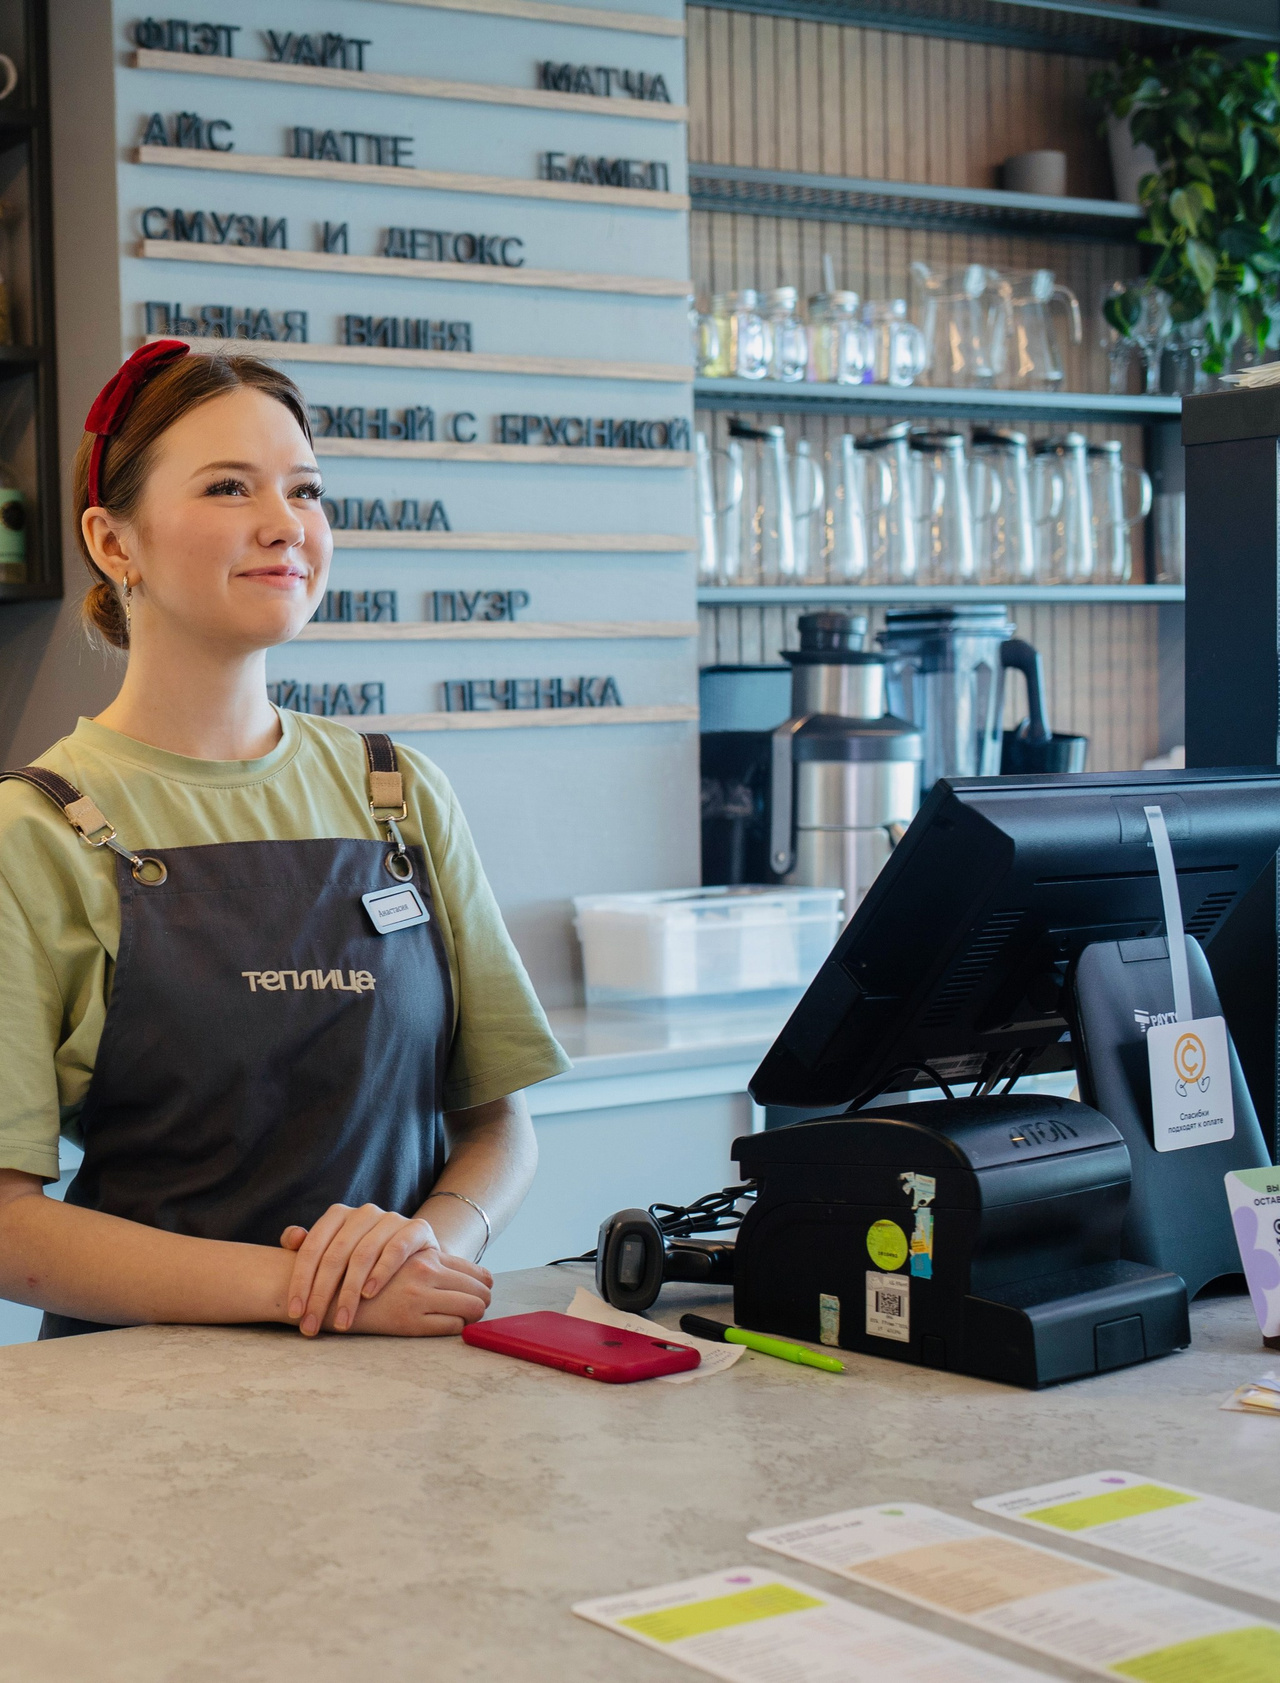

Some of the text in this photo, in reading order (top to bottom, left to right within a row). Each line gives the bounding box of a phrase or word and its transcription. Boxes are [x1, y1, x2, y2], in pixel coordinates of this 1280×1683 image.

[266, 29, 371, 72] УАЙТ
[540, 60, 672, 103] МАТЧА
[143, 111, 415, 169] АЙС ЛАТТЕ
[544, 151, 669, 193] БАМБЛ
[141, 207, 524, 268] СМУЗИ И ДЕТОКС
[144, 301, 473, 353] ПЬЯНАЯ ВИШНЯ
[453, 412, 477, 442] С
[499, 413, 691, 451] БРУСНИКОЙ
[433, 590, 531, 622] ПУЭР
[266, 675, 623, 716] ЙНАЯ ПЕЧЕНЬКА
[1150, 1012, 1178, 1026] PAYT
[1168, 1122, 1197, 1133] подходят
[1203, 1118, 1224, 1127] оплате
[1180, 1109, 1209, 1120] Спасибки
[1267, 1184, 1279, 1193] ВЫ
